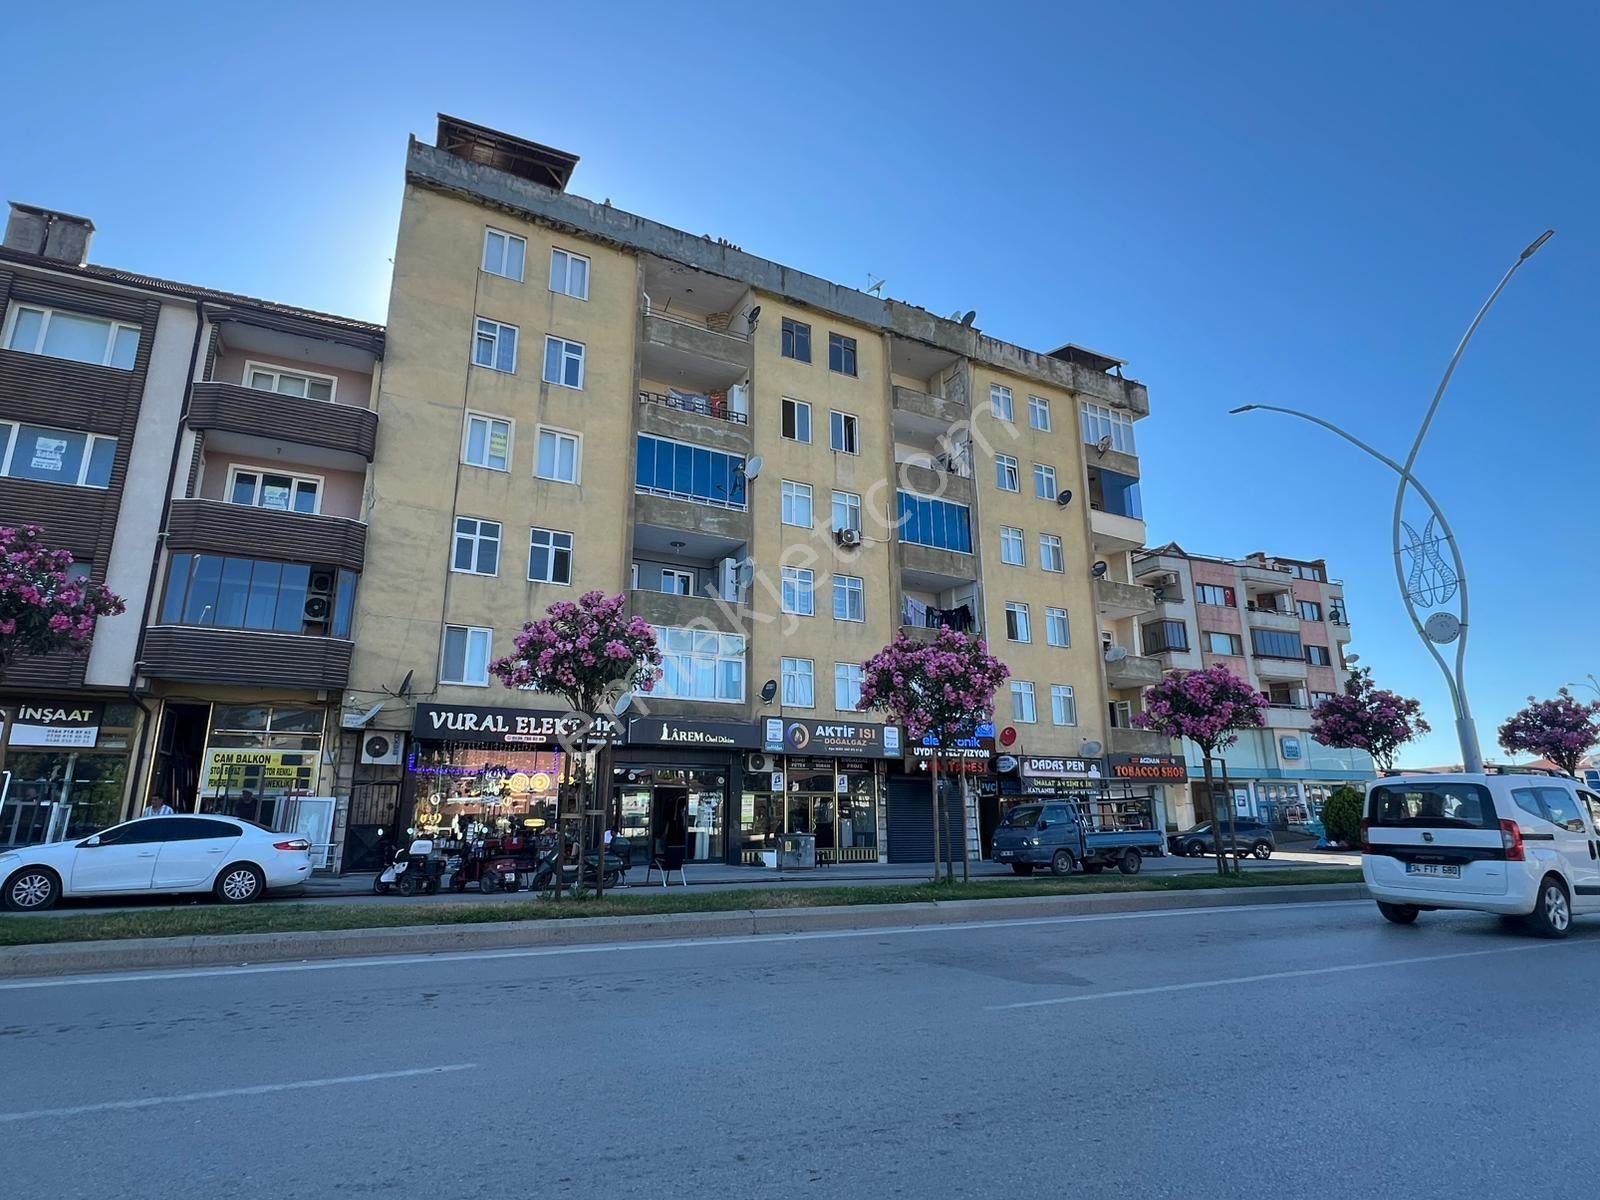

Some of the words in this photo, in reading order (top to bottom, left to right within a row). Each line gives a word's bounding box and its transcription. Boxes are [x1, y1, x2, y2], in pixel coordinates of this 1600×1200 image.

[18, 704, 94, 724] İNŞAAT
[429, 711, 509, 735] VURAL
[815, 725, 855, 740] AKTİF
[859, 728, 876, 740] ISI
[824, 738, 867, 747] DOĞALGAZ
[213, 753, 234, 764] CAM
[235, 754, 273, 765] BALKON
[1031, 759, 1064, 774] DADAŞ
[1066, 760, 1085, 772] PEN
[1115, 765, 1160, 777] TOBACCO
[1161, 766, 1185, 778] SHOP
